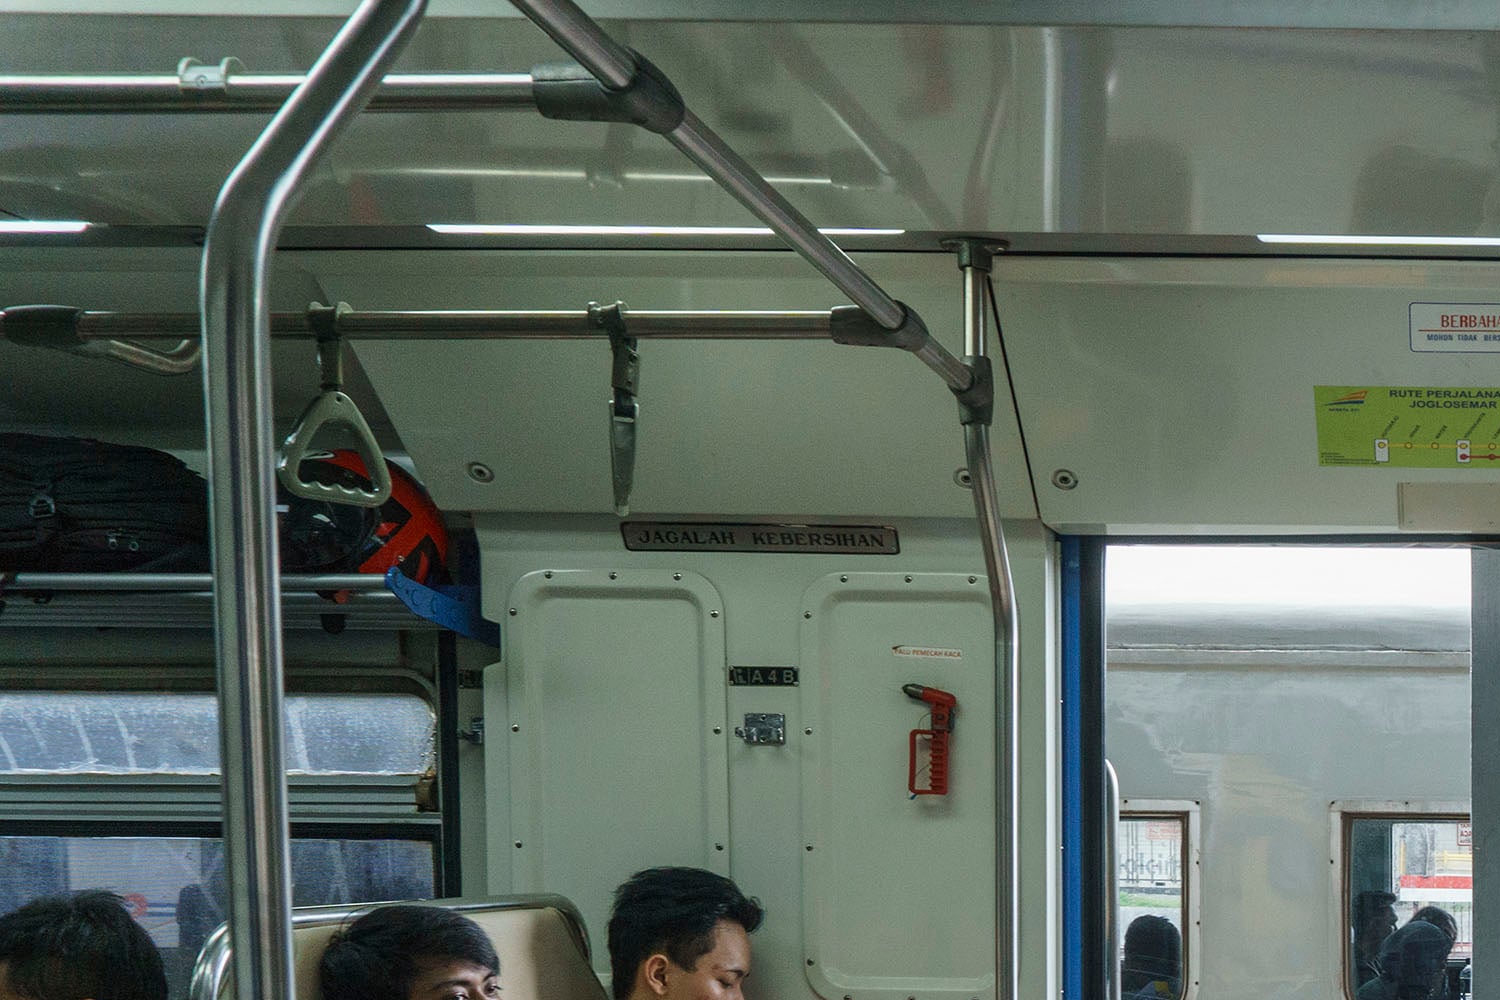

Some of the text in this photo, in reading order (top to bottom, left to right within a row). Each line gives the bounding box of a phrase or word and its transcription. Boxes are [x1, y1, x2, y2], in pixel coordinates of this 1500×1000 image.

[1426, 333, 1454, 342] MOHON
[1457, 333, 1478, 342] TIDAK
[1389, 389, 1423, 398] RUTE
[1408, 400, 1498, 409] JOGLOSEMAR
[637, 530, 885, 548] JAGALAH KEBERSIHAN
